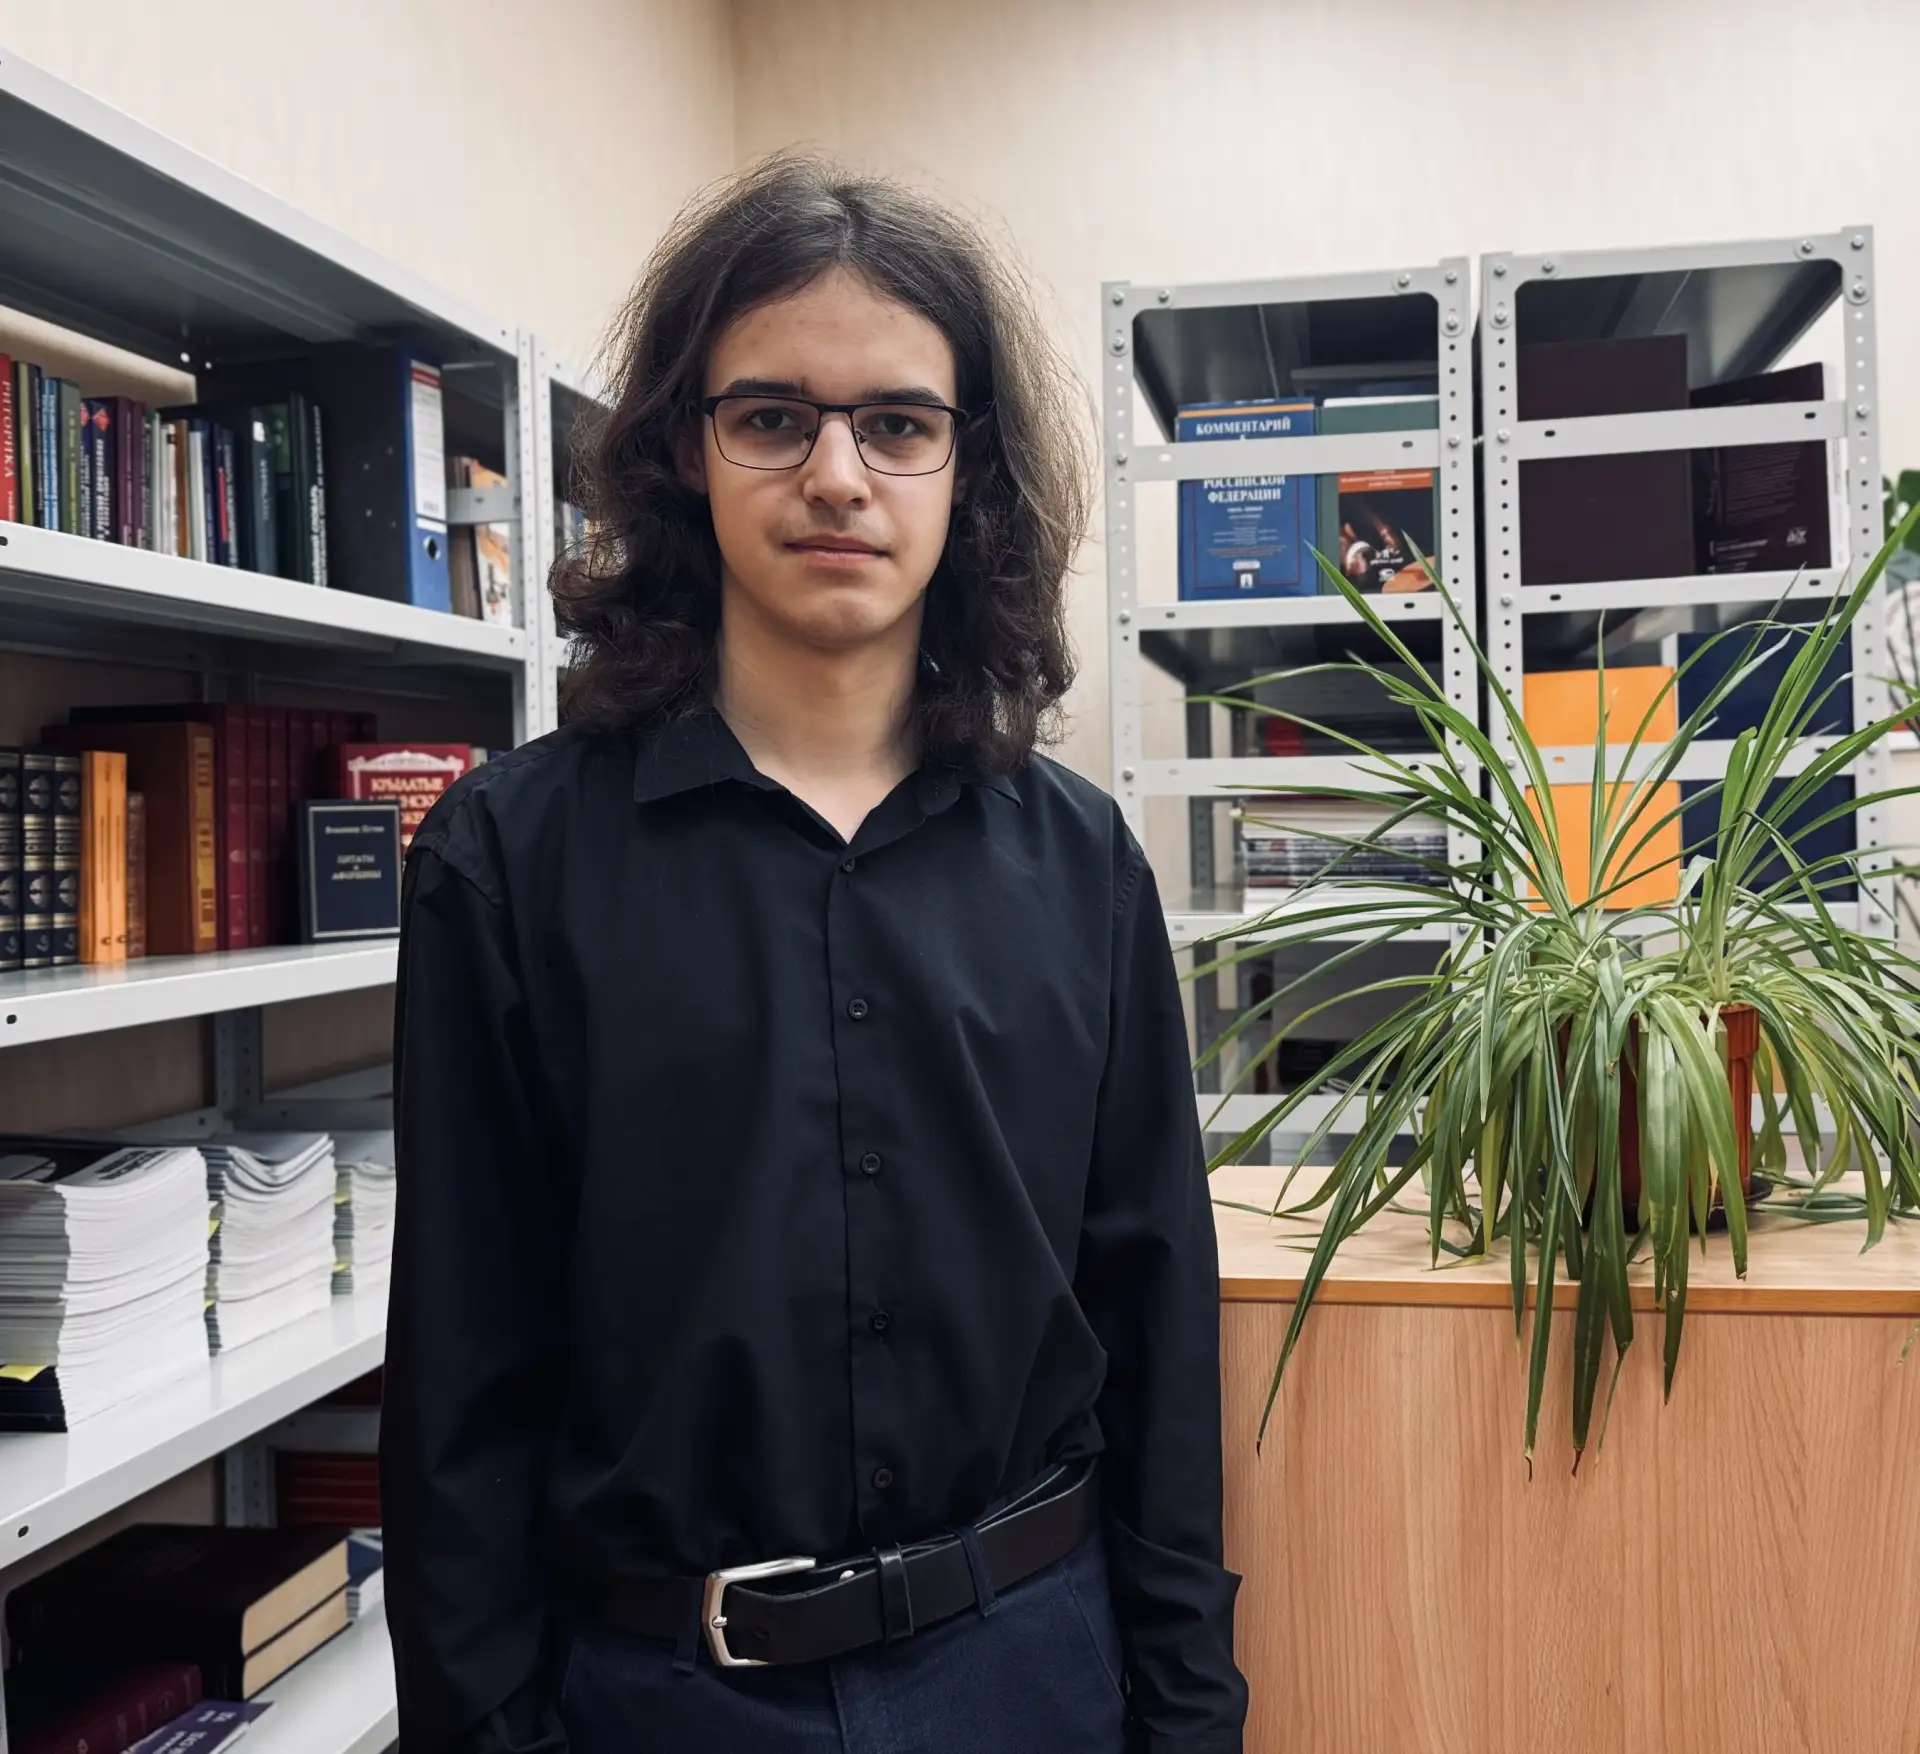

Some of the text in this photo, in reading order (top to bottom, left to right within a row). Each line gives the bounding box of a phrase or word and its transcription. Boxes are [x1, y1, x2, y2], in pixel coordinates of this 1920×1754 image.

[1196, 416, 1291, 435] КОММЕНТАРИЙ
[1208, 488, 1281, 503] ФЕДЕРАЦИИ
[371, 777, 444, 793] КРЫЛАТЫЕ
